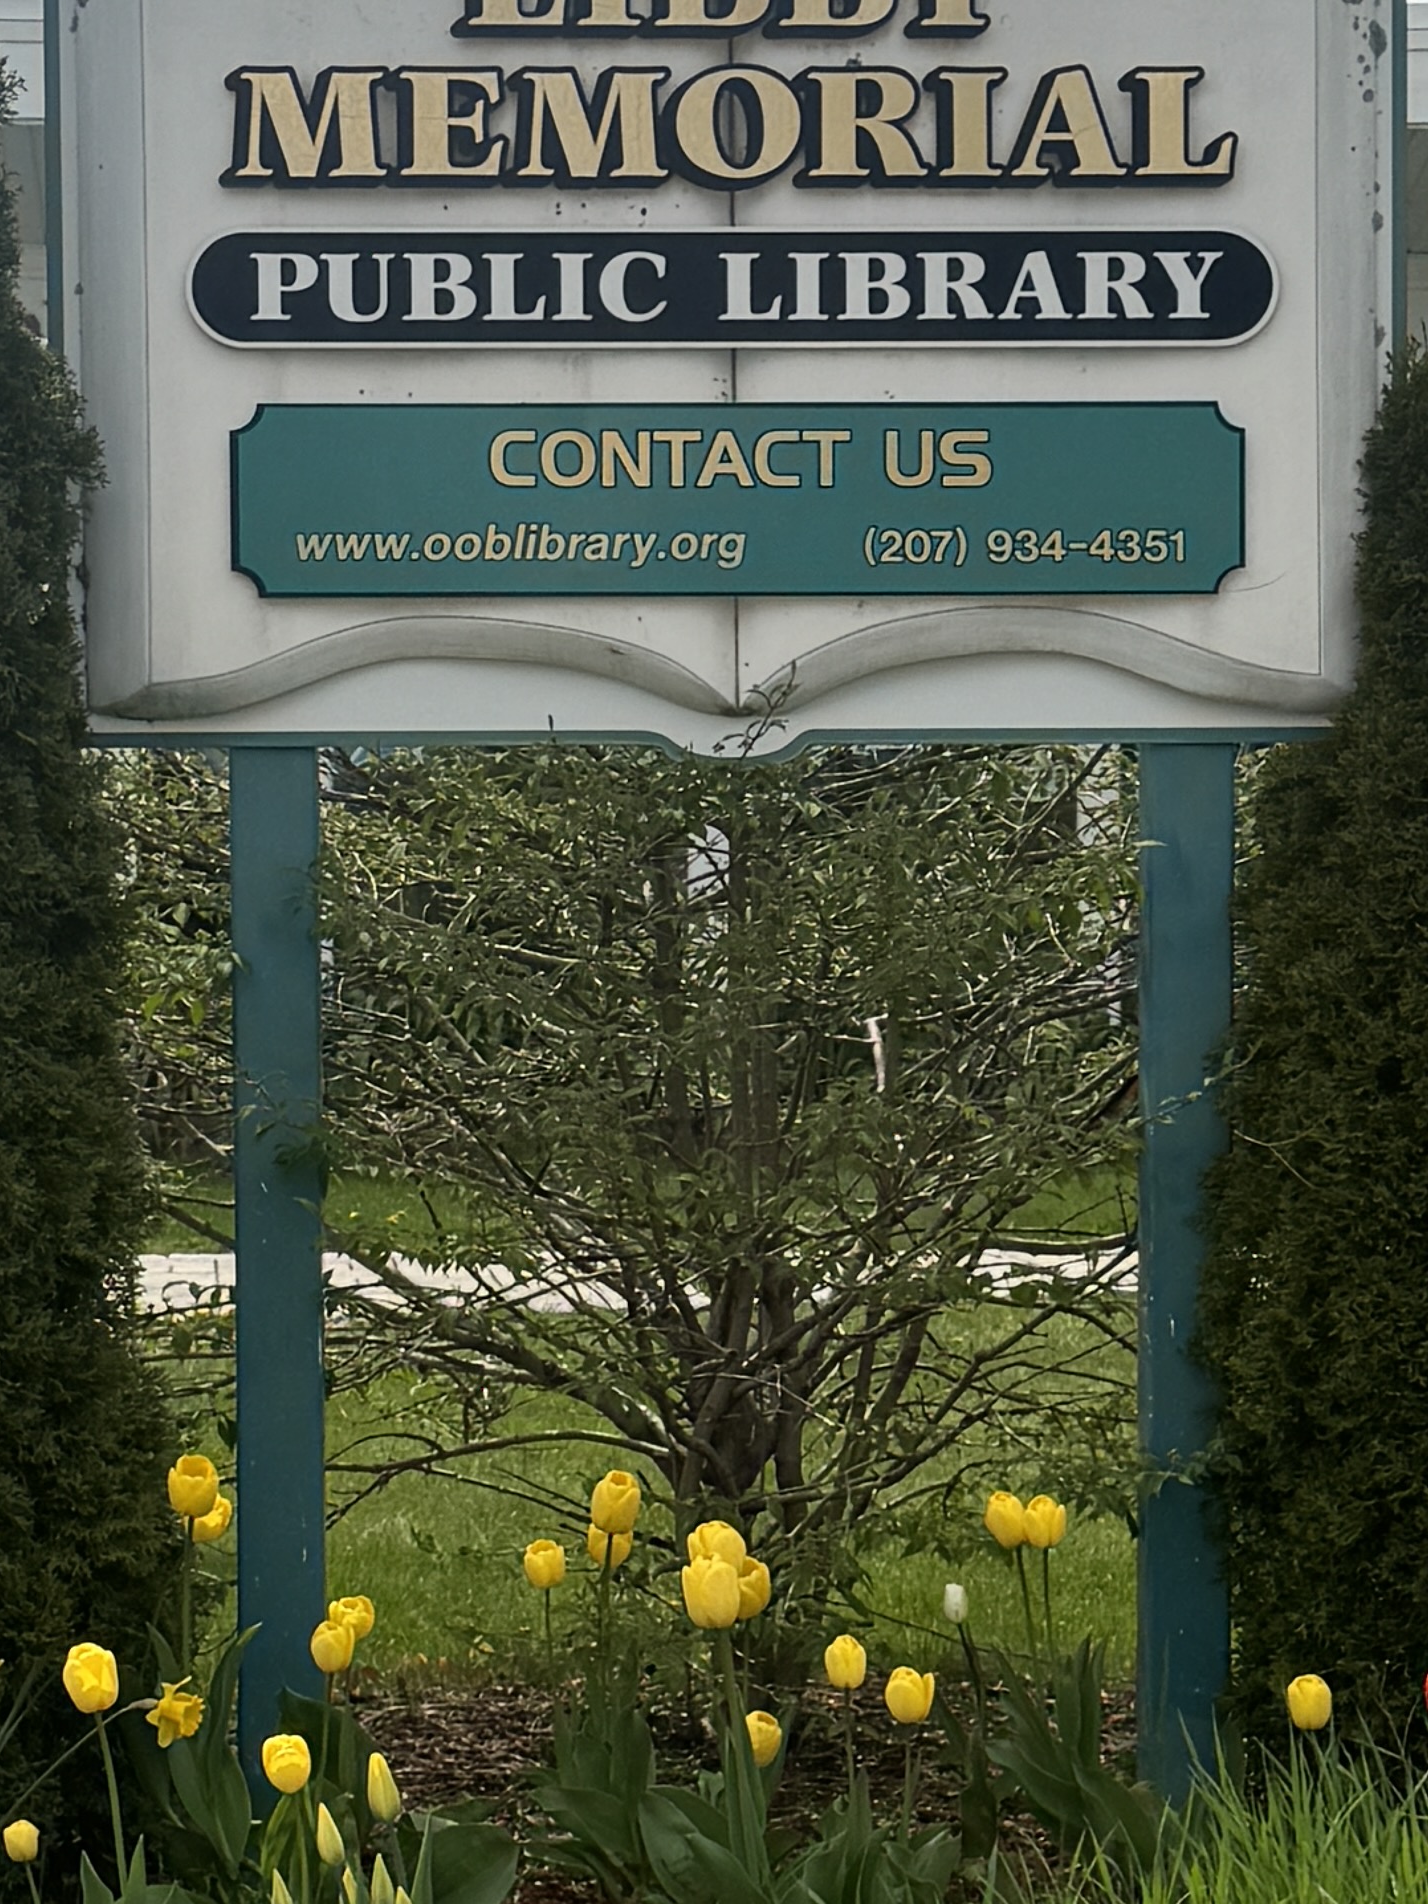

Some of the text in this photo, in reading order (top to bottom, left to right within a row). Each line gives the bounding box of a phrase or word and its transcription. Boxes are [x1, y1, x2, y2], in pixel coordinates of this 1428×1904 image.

[220, 62, 1239, 190] MEMORIAL
[249, 250, 1224, 323] PUBLIC LIBRARY
[489, 429, 995, 489] CONTACT US
[295, 522, 1188, 569] www.ooblibrary.org (207) 934-4351
